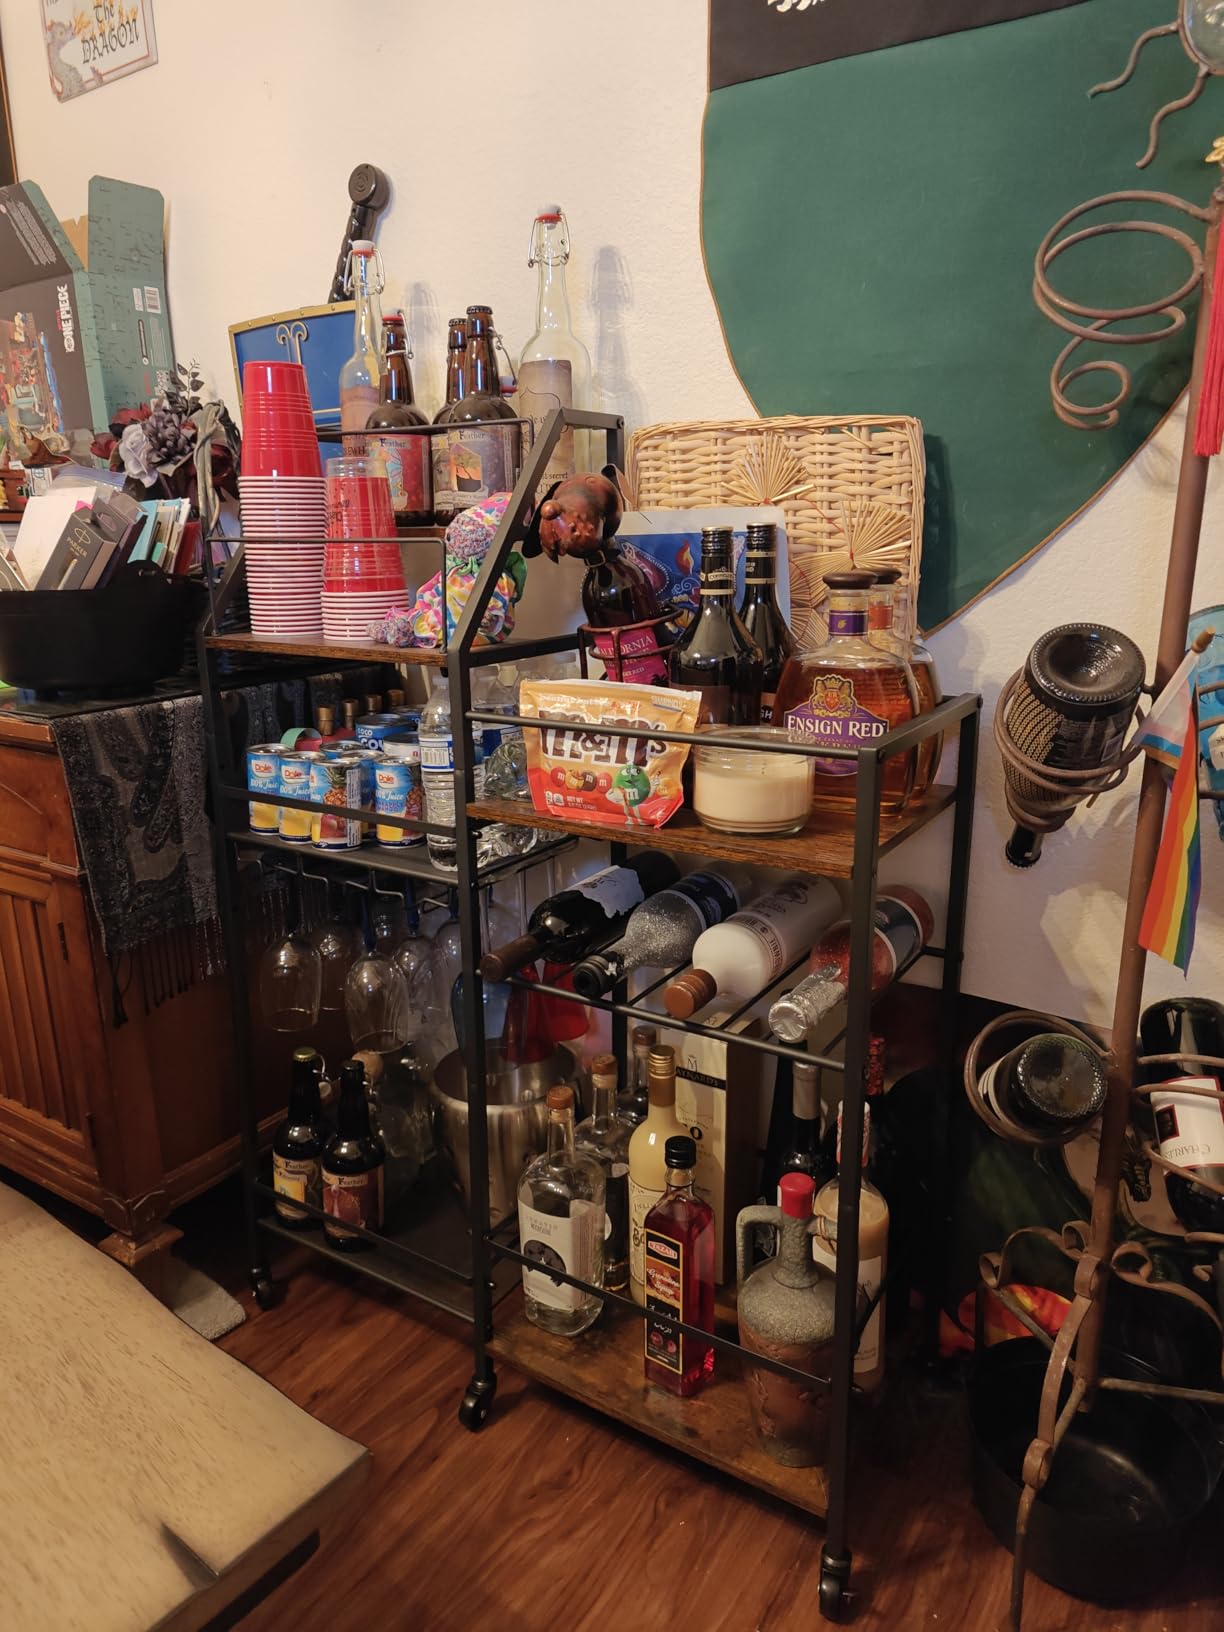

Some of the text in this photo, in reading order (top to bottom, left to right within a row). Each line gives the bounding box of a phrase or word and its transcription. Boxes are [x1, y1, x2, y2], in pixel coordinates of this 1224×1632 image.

[81, 18, 139, 64] DRAGON
[57, 283, 72, 320] PIECE
[61, 320, 75, 352] ONE
[787, 714, 843, 735] ENSIGN
[848, 721, 884, 739] RED
[255, 763, 272, 774] Dole
[284, 769, 303, 778] Dole
[378, 773, 394, 784] Dole
